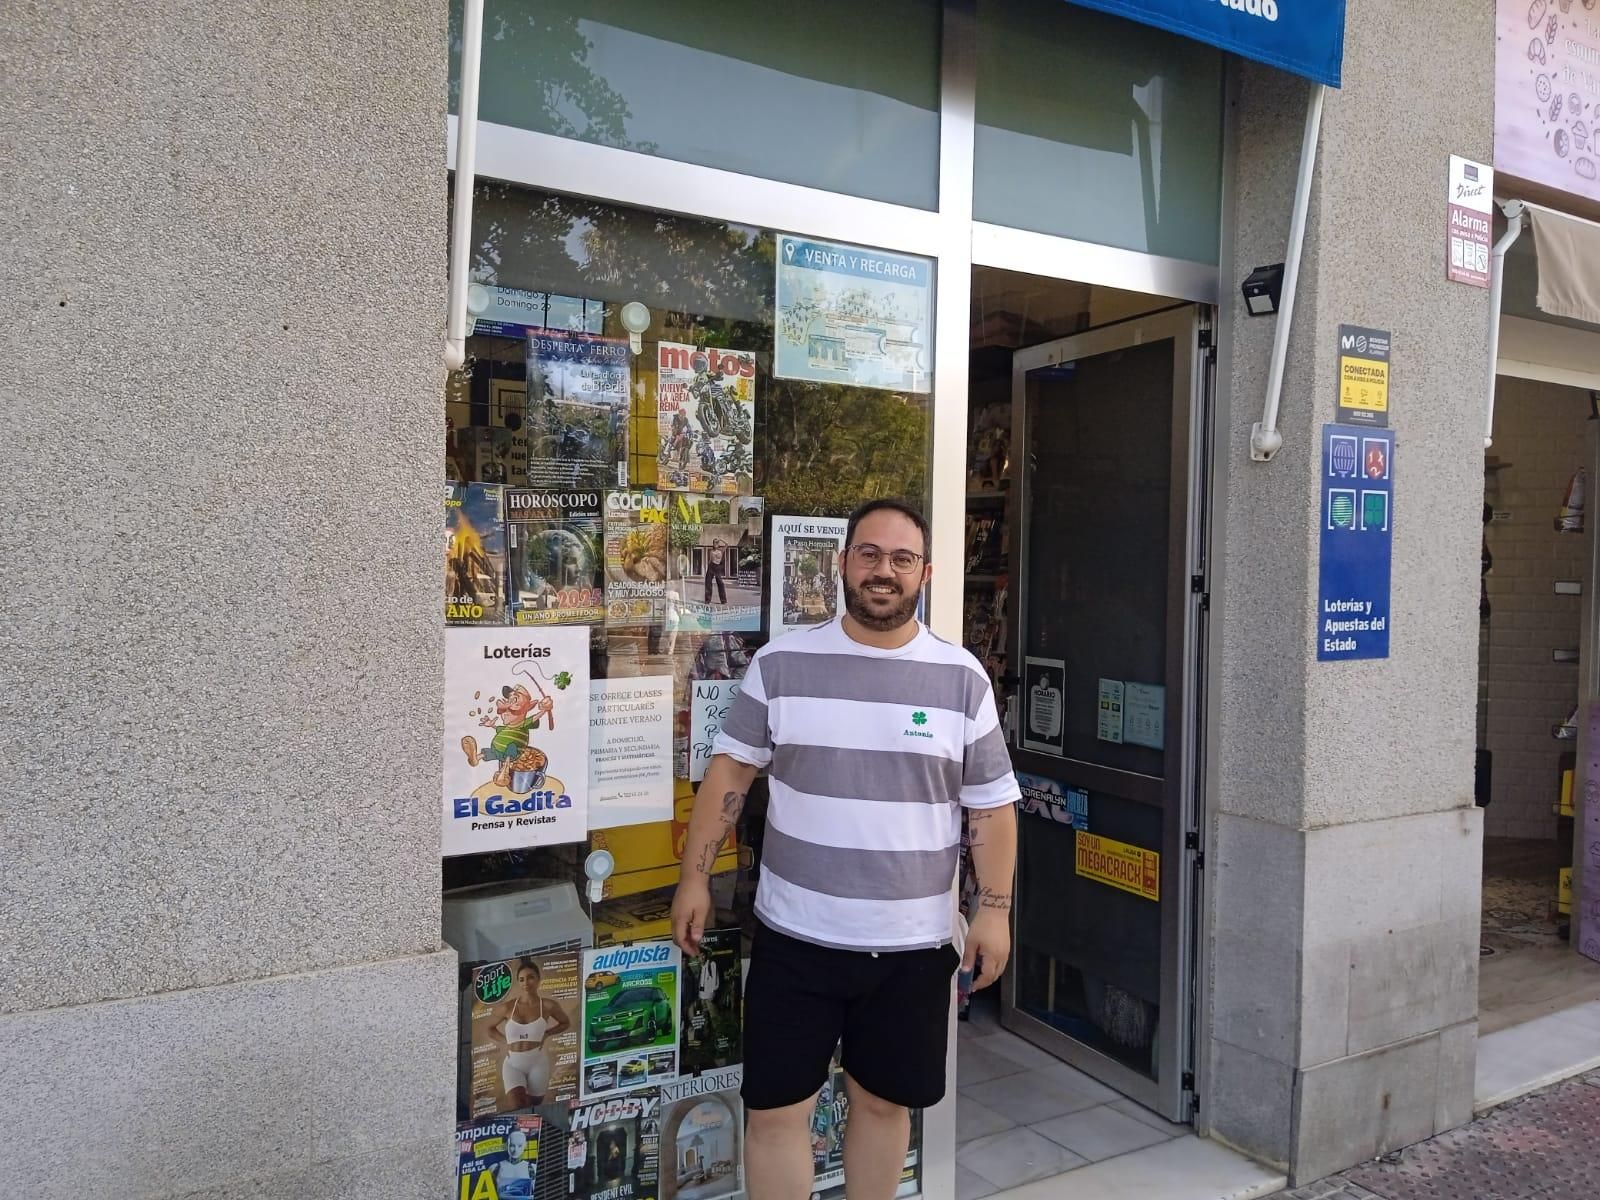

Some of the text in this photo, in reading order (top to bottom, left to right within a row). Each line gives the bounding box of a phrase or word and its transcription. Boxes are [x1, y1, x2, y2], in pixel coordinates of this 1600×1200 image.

[1452, 209, 1488, 234] Alarma
[805, 248, 916, 280] VENTA Y RECARGA
[497, 297, 538, 311] Domingo
[531, 338, 626, 357] DESPERTA FERRO
[660, 346, 755, 378] motos
[1344, 365, 1385, 379] CONECTADA
[591, 379, 626, 393] Breda
[660, 383, 685, 394] VUELVE
[660, 402, 680, 412] REINA
[510, 491, 598, 509] HORÓSCOPO
[778, 523, 846, 536] AQUÍ SE VENDE
[608, 581, 635, 590] ASADOS
[1325, 598, 1372, 614] Loterías y
[522, 612, 532, 620] UN
[533, 611, 549, 620] AÑO
[1325, 617, 1385, 636] Apuestas del
[483, 643, 551, 660] Loterías
[1324, 638, 1357, 652] Estado
[589, 690, 662, 702] SE OFRECE CLASES
[697, 686, 719, 700] NO
[597, 703, 654, 713] PARTICULARES
[589, 714, 662, 727] DURANTE VERANO
[903, 729, 933, 738] Antonio
[453, 797, 478, 818] El
[485, 790, 572, 816] Gadita
[1020, 786, 1066, 806] ADRENALYN
[471, 815, 556, 831] Prensa y Revistas
[1078, 833, 1089, 847] SOY
[1078, 847, 1141, 886] MEGACRACK
[593, 945, 670, 970] autopista
[477, 964, 505, 988] Sport
[622, 978, 652, 988] AIRCROSS
[483, 974, 511, 1000] Life
[662, 1071, 740, 1103] NTERIORES
[570, 1097, 659, 1131] HOBBY
[455, 1121, 512, 1141] omputer
[460, 1169, 499, 1200] IA
[620, 1184, 634, 1197] EVIL
